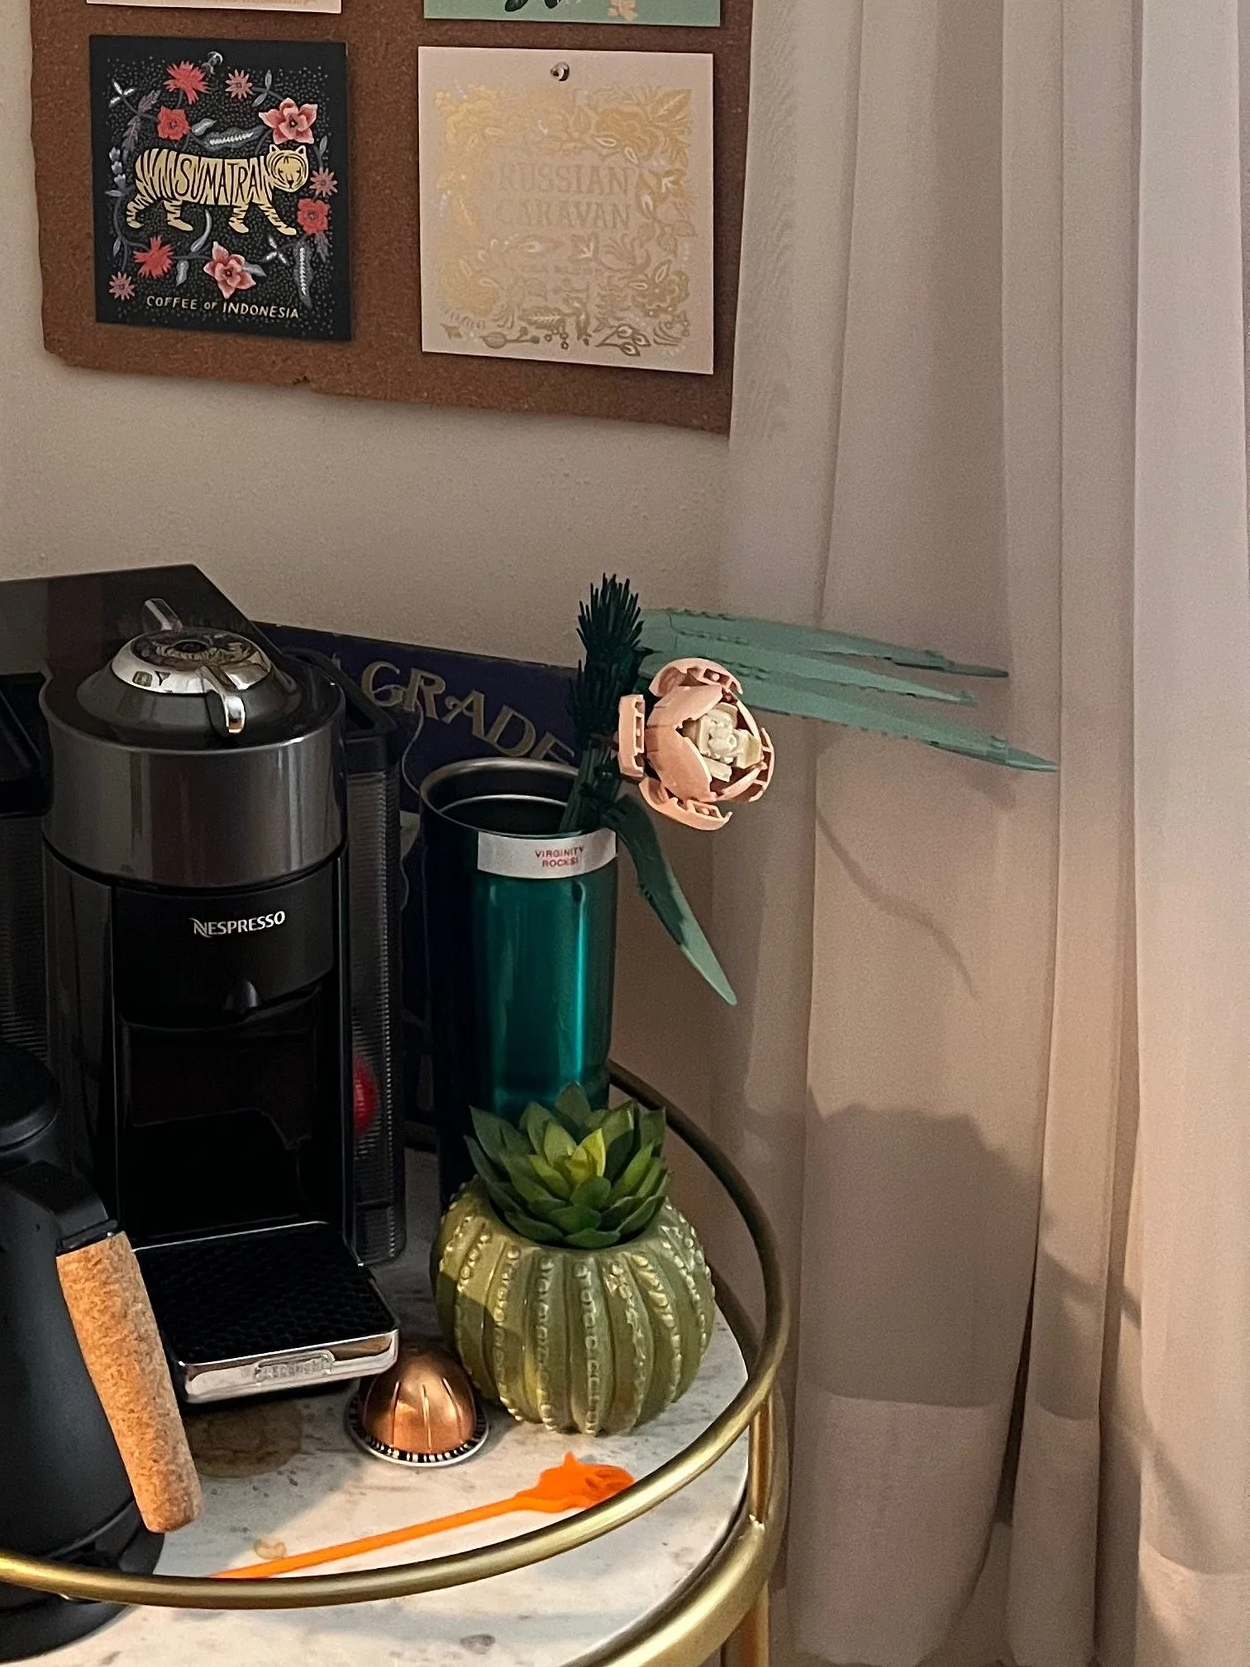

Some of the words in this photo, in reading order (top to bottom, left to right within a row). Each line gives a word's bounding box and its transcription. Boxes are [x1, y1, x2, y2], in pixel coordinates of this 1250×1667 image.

[498, 161, 634, 196] RUSSIAN
[146, 295, 198, 310] COFFEE
[222, 301, 299, 319] INDONESIA
[534, 845, 584, 858] VIRGINITY
[188, 910, 286, 938] NESPRESSO
